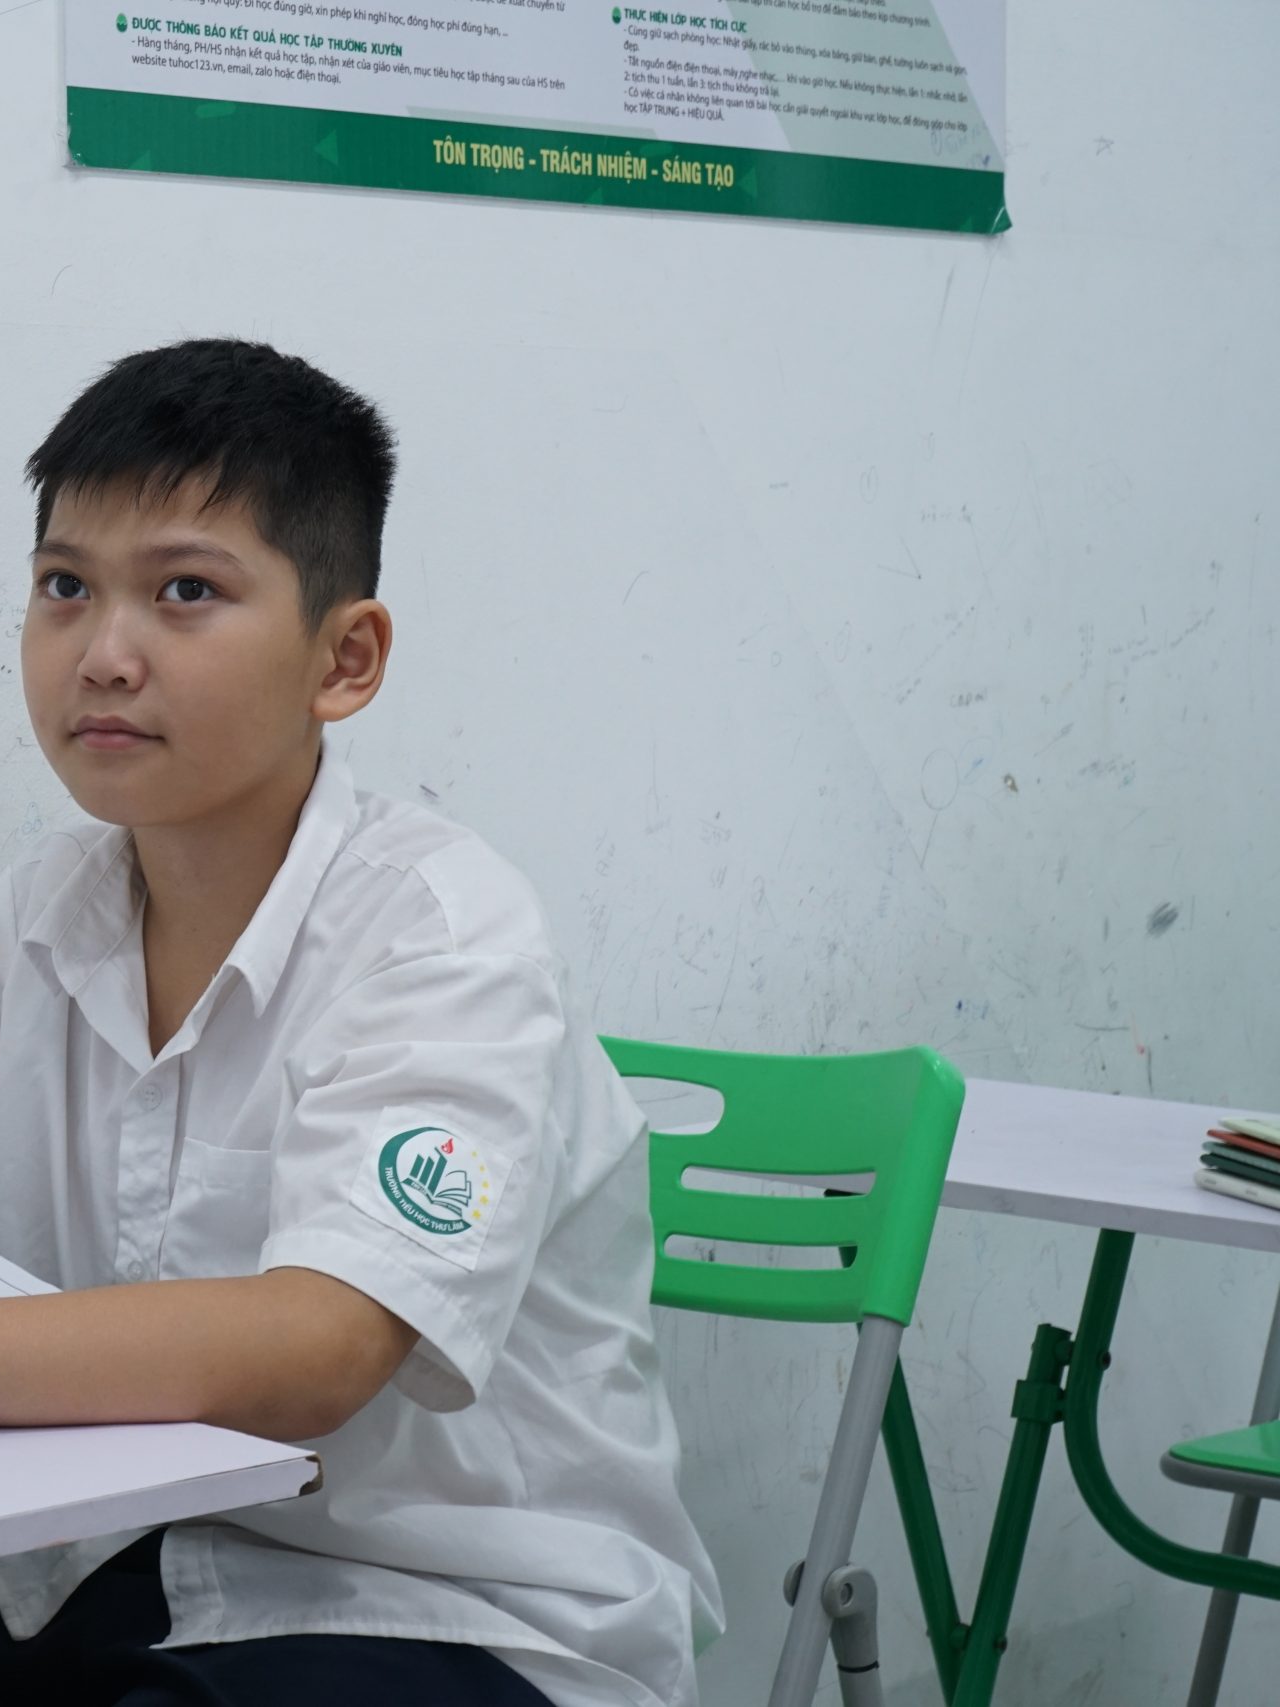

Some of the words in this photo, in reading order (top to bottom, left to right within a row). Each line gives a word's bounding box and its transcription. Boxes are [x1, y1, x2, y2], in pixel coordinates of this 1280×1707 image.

[131, 18, 161, 35] ĐƯỢC
[166, 19, 200, 36] THÔNG
[204, 22, 226, 39] BÁO
[230, 25, 248, 41] KẾT
[252, 27, 275, 44] QUẢ
[279, 33, 299, 49] HỌC
[303, 32, 324, 51] TẬP
[327, 35, 366, 53] THƯỜNG
[371, 39, 402, 56] XUYÊN
[137, 36, 161, 52] Hàng
[163, 39, 192, 55] tháng,
[194, 42, 222, 55] PH/HS
[224, 45, 247, 61] nhận
[248, 45, 262, 60] kết
[264, 49, 280, 64] quả
[282, 51, 298, 66] học
[300, 53, 317, 68] tập,
[318, 55, 339, 70] nhận
[341, 57, 354, 69] xét
[356, 58, 371, 70] của
[373, 60, 391, 75] giáo
[392, 62, 412, 76] viên,
[413, 66, 432, 79] mục
[433, 66, 449, 78] tiêu
[450, 68, 465, 83] học
[467, 69, 480, 84] tập
[481, 71, 505, 87] tháng
[506, 76, 520, 86] sau
[521, 75, 535, 87] của
[536, 77, 548, 88] HS
[549, 78, 565, 90] trên
[131, 53, 167, 67] website
[168, 57, 225, 74] tuhoc123.vn,
[227, 62, 253, 77] email,
[254, 65, 272, 77] zalo
[274, 67, 295, 82] hoặc
[296, 69, 315, 84] điện
[317, 71, 341, 87] thoại.
[433, 135, 466, 166] TÔN
[470, 143, 524, 174] TRỌNG
[540, 146, 592, 176] TRÁCH
[597, 151, 647, 184] NHIỆM
[662, 155, 702, 185] SÁNG
[705, 164, 734, 191] TẠO
[385, 1166, 401, 1199] TRƯỜNG
[414, 1211, 430, 1227] HỌC
